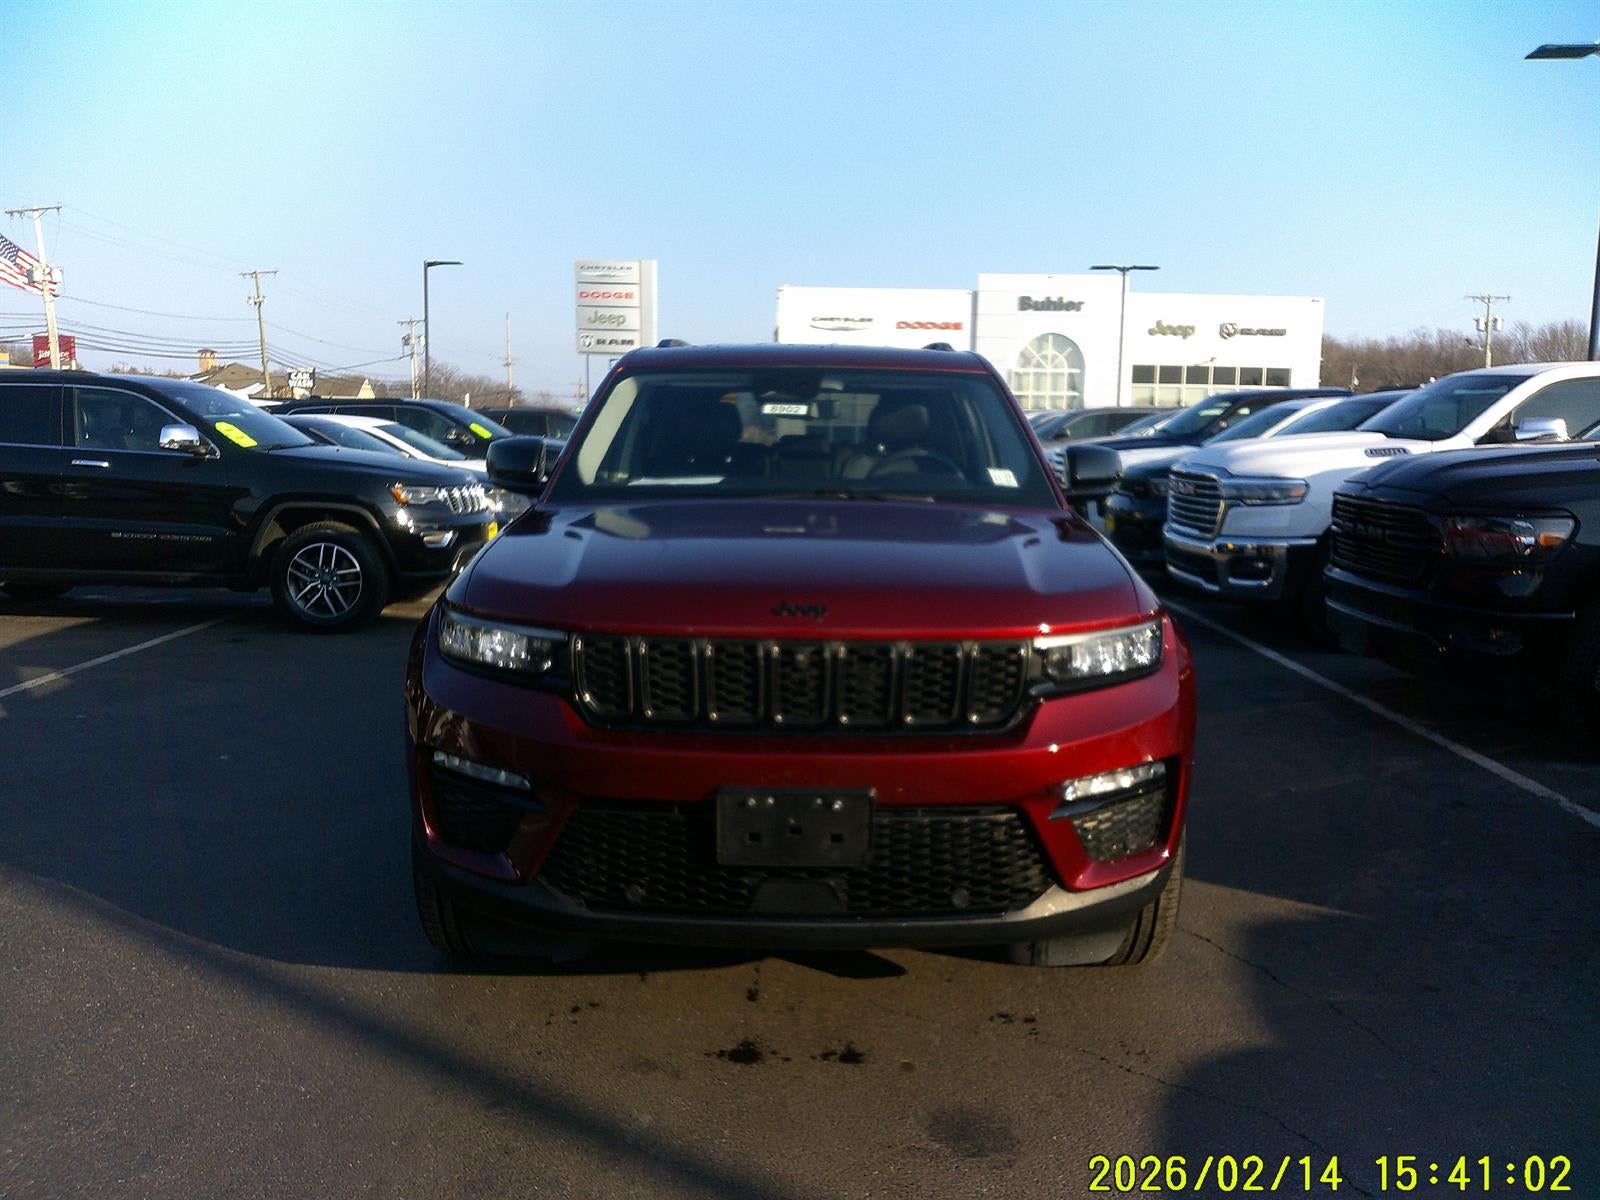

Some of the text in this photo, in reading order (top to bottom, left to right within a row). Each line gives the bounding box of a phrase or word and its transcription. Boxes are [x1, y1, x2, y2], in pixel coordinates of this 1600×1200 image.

[579, 291, 634, 299] DODGE
[1018, 295, 1085, 312] Buhler
[588, 310, 626, 326] Jeep
[896, 320, 964, 330] DODGE
[1148, 319, 1196, 339] Jeep
[596, 338, 635, 346] RAM
